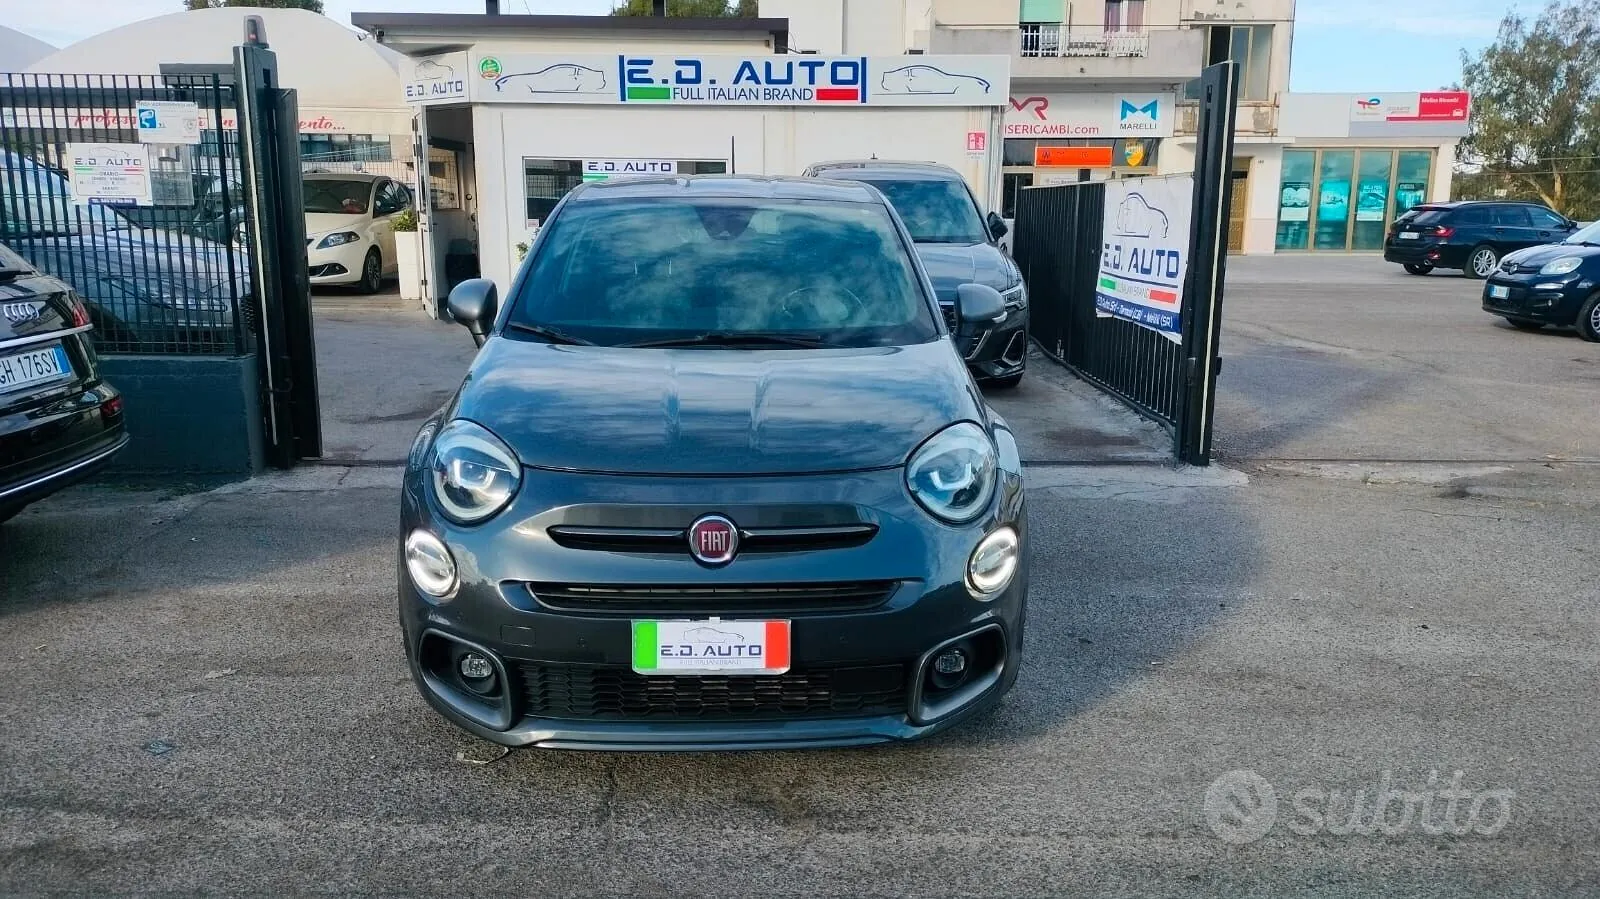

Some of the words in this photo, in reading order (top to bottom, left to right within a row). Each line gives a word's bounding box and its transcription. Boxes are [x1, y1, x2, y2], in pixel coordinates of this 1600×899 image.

[627, 59, 716, 85] E.D.
[733, 60, 859, 86] AUTO
[406, 85, 428, 97] E.D.
[431, 80, 463, 95] AUTO
[673, 87, 704, 100] FULL
[707, 87, 758, 100] ITALIAN
[763, 87, 813, 100] BRAND
[1003, 123, 1099, 136] ISERICAMBI.com
[1119, 122, 1157, 131] MARELLI
[105, 158, 142, 166] AUTO
[588, 161, 620, 172] E.D.
[623, 162, 672, 172] AUTO
[1103, 243, 1123, 271] E.D.
[1128, 247, 1179, 278] AUTO
[18, 350, 58, 378] 176SV
[701, 530, 728, 551] FIAT
[661, 645, 698, 657] E.D.
[703, 645, 762, 657] AUTO
